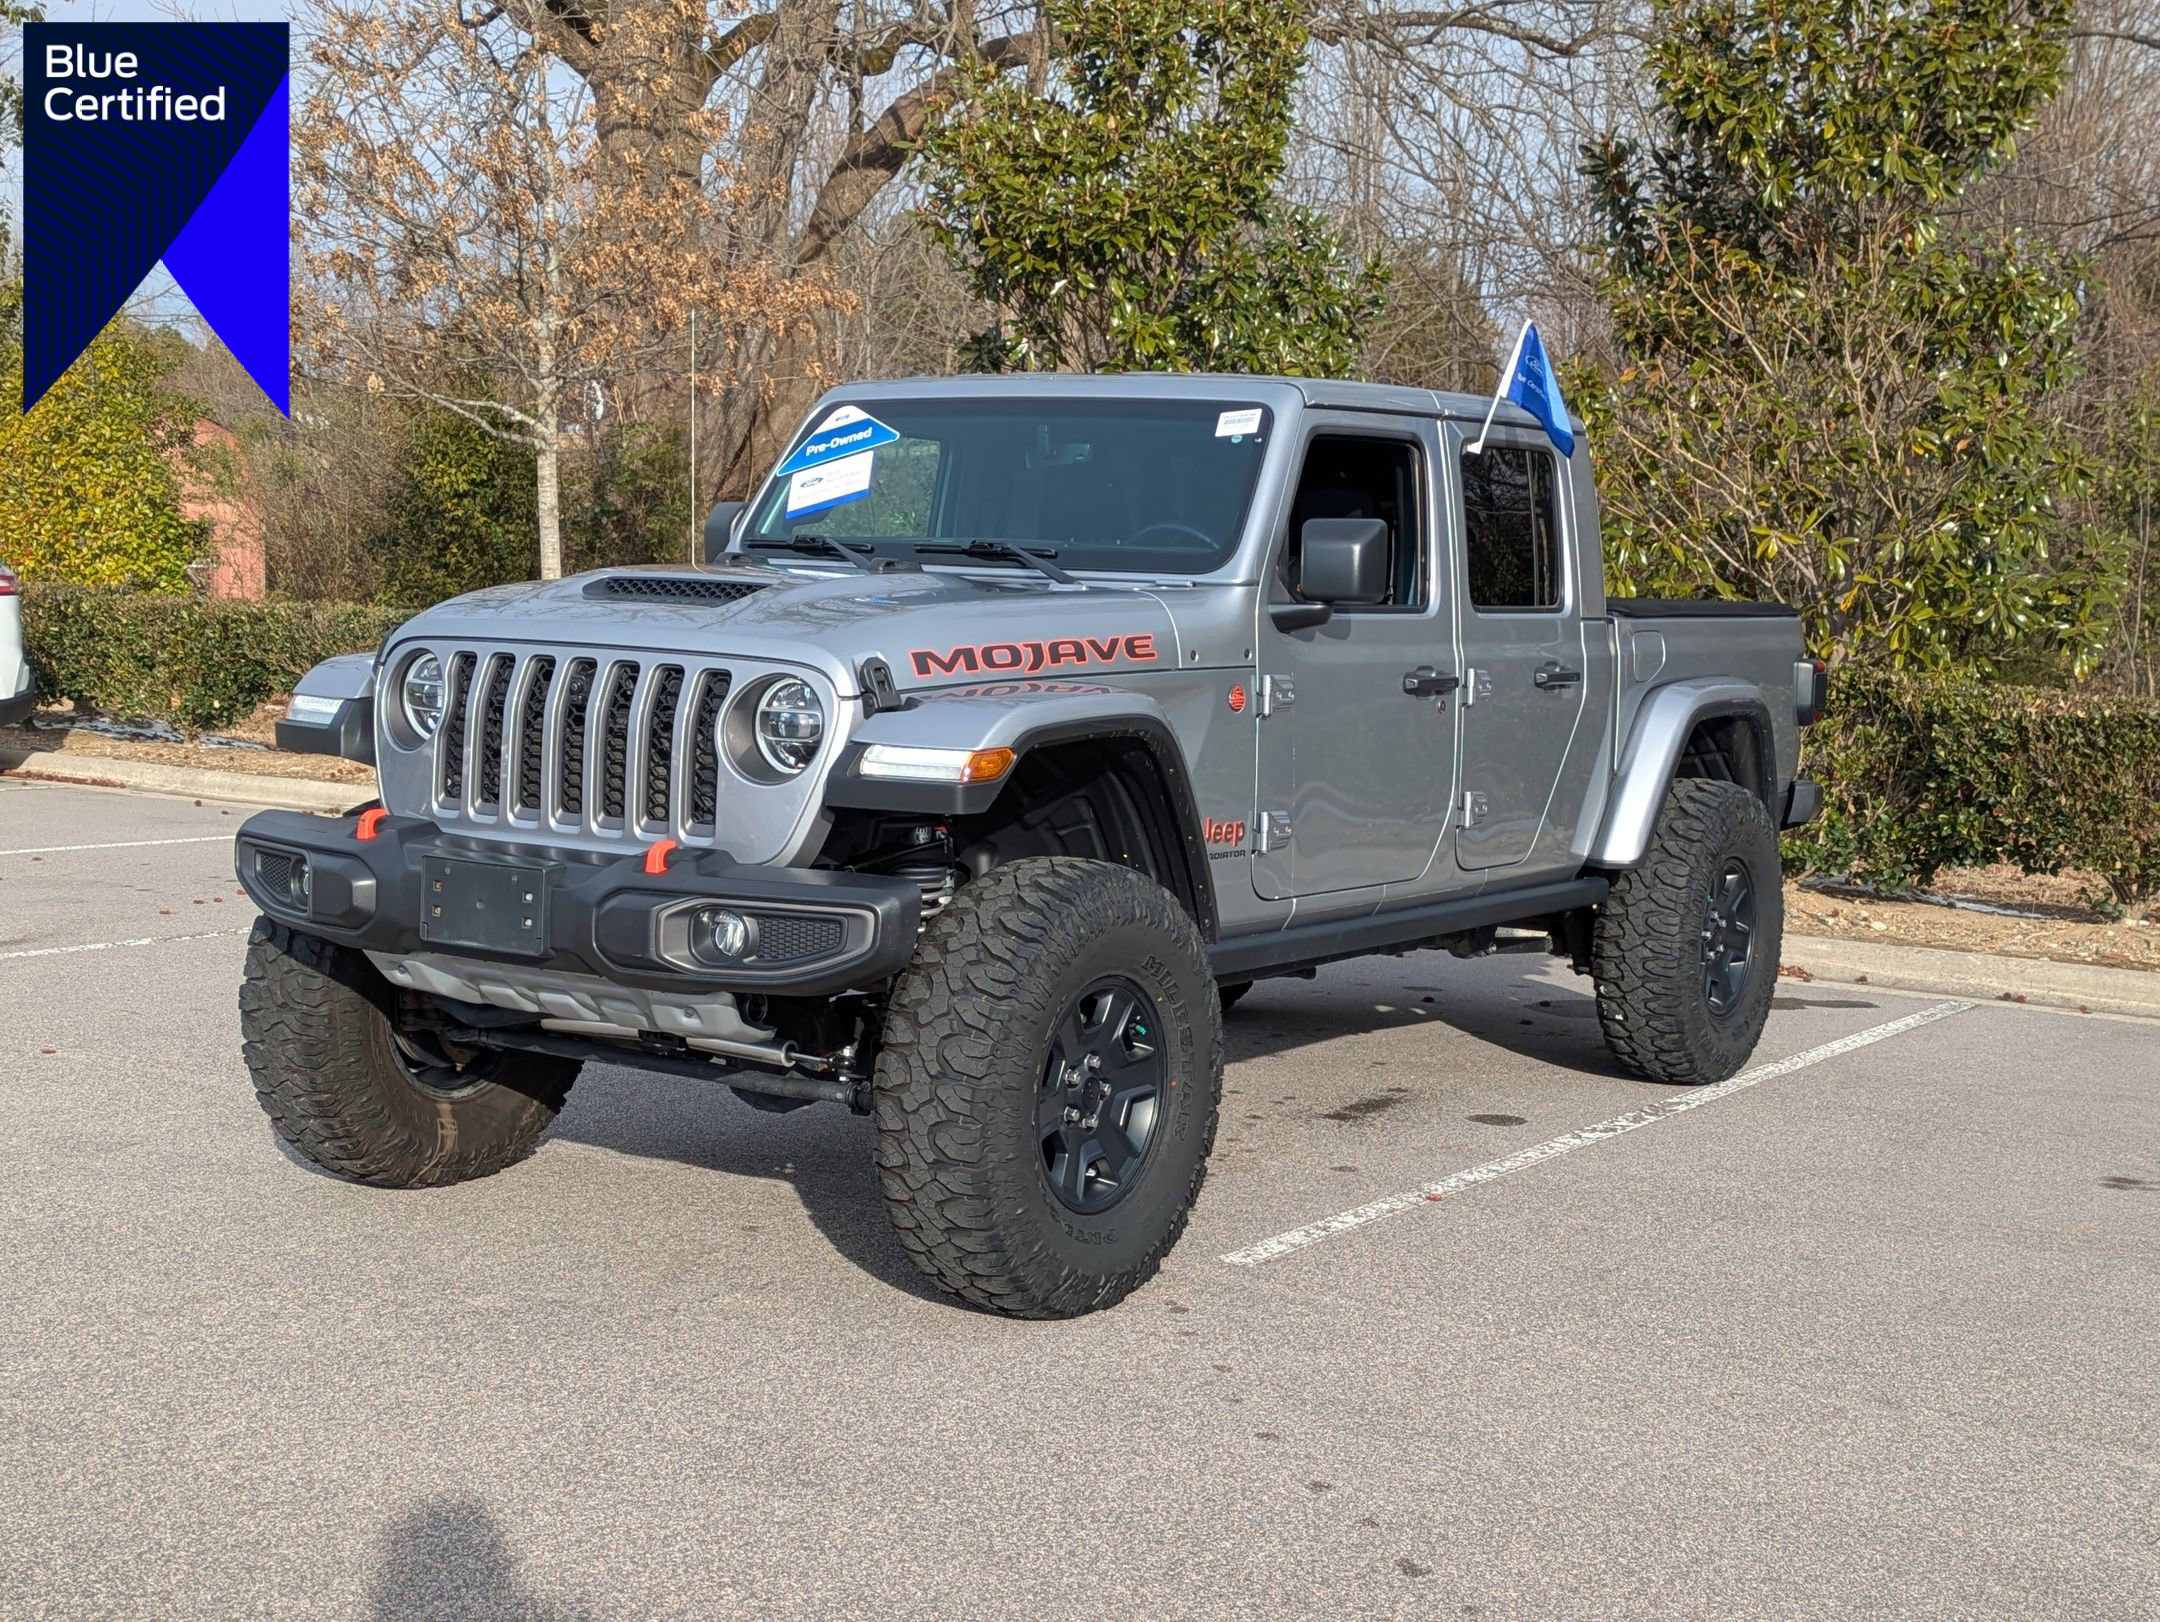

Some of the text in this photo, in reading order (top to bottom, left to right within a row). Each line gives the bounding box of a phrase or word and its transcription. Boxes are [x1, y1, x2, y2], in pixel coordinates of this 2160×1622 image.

[805, 426, 873, 456] Pre-Owned
[911, 634, 1157, 677] MOJAVE
[1204, 816, 1245, 848] Jeep
[1142, 955, 1195, 1141] MILESTAR
